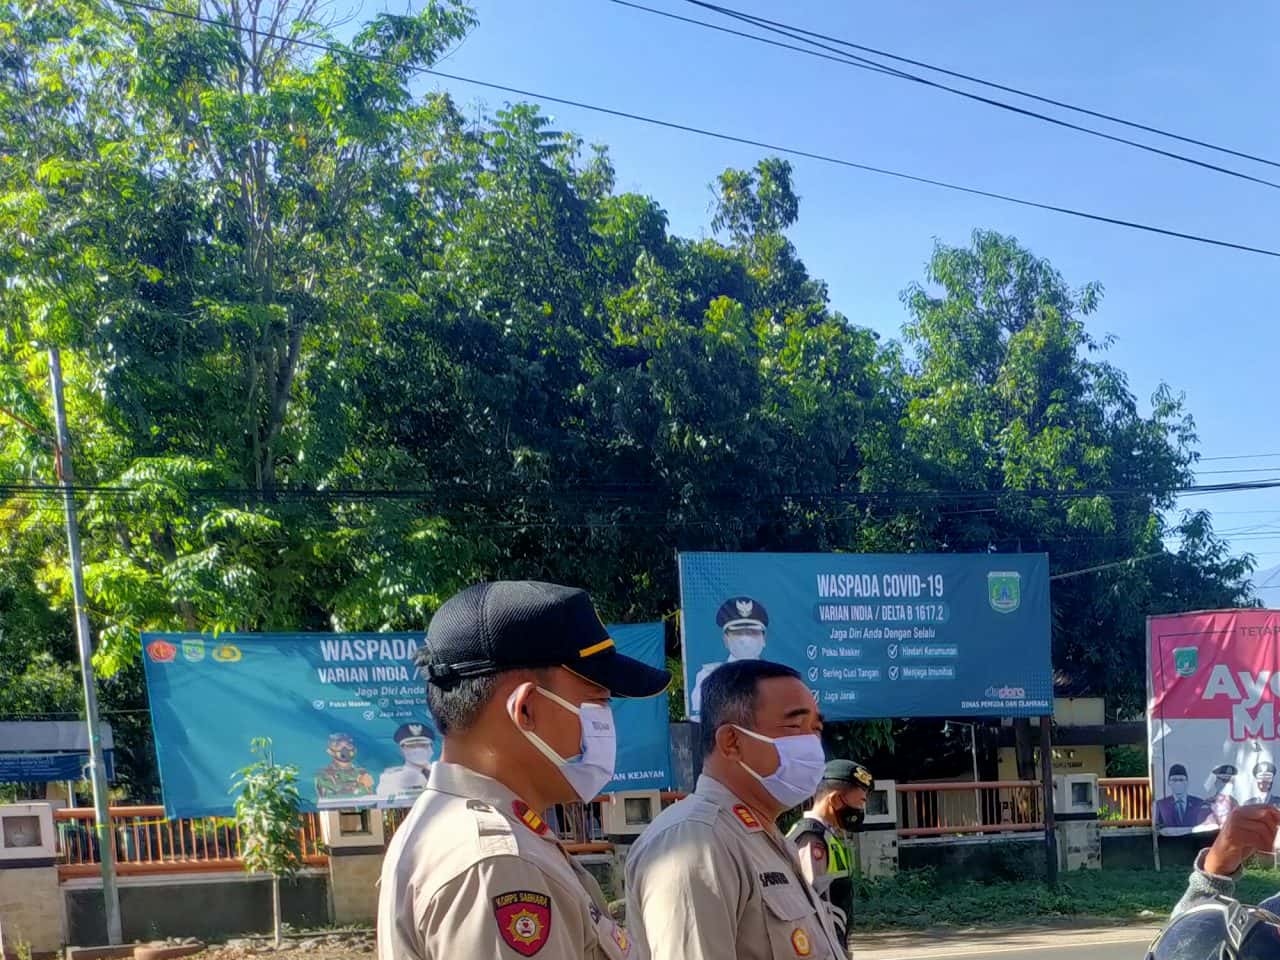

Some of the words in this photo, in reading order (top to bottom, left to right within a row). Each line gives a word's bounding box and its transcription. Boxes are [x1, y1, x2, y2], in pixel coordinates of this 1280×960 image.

[817, 574, 880, 598] WASPADA
[883, 574, 944, 598] COVID-19
[819, 605, 849, 621] VARIAN
[850, 605, 873, 621] INDIA
[881, 605, 906, 621] DELTA
[830, 628, 847, 641] Jaga
[849, 627, 862, 639] Diri
[863, 627, 882, 639] Anda
[884, 627, 911, 641] Dengan
[913, 627, 936, 639] Selalu
[1240, 626, 1280, 637] TETAP
[319, 638, 418, 662] WASPADA
[318, 667, 368, 684] VARIAN
[372, 666, 409, 682] INDIA
[355, 687, 378, 698] Jaga
[381, 686, 398, 696] Diri
[399, 686, 425, 695] Anda
[628, 771, 664, 780] KEJAYAN
